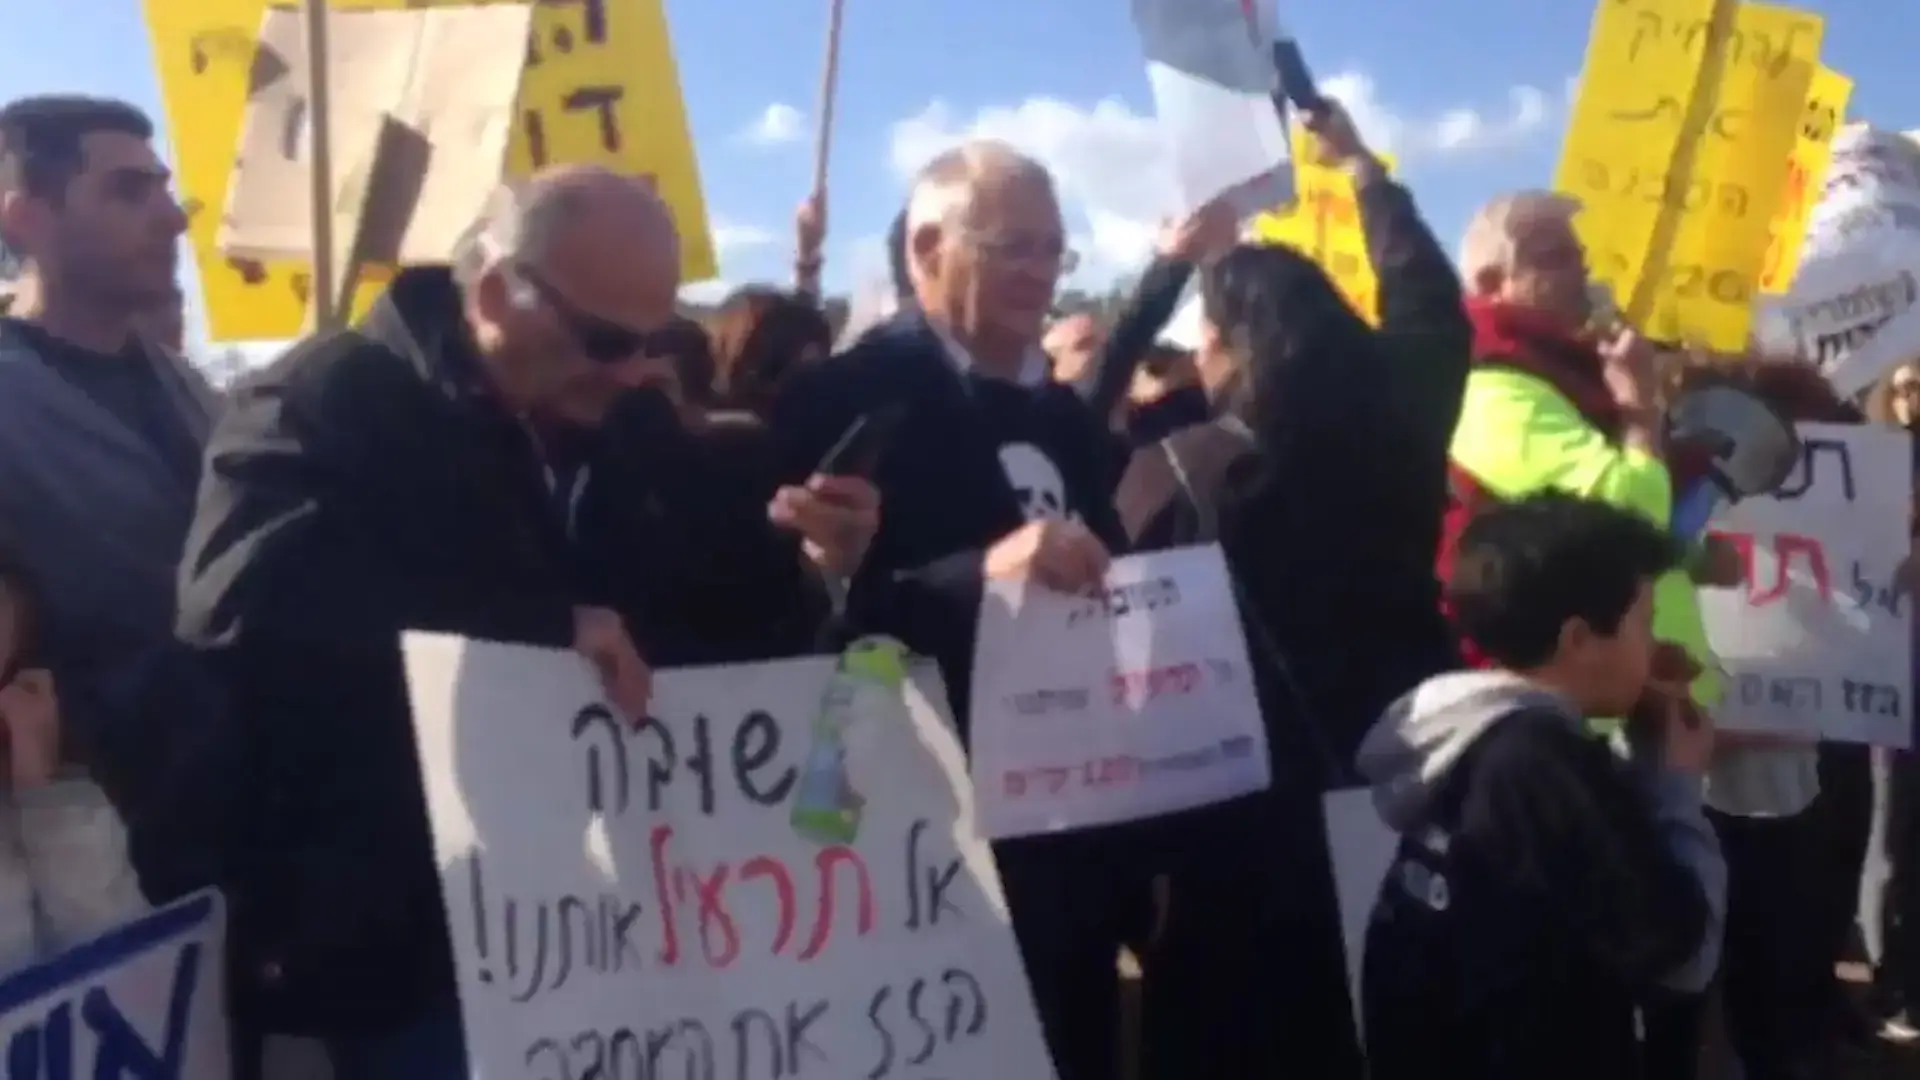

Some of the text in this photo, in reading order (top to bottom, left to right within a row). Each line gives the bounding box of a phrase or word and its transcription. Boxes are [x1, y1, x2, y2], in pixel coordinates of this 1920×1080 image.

[650, 823, 878, 968] תרעיל
[904, 819, 966, 931] אל
[867, 967, 988, 1080] הזז
